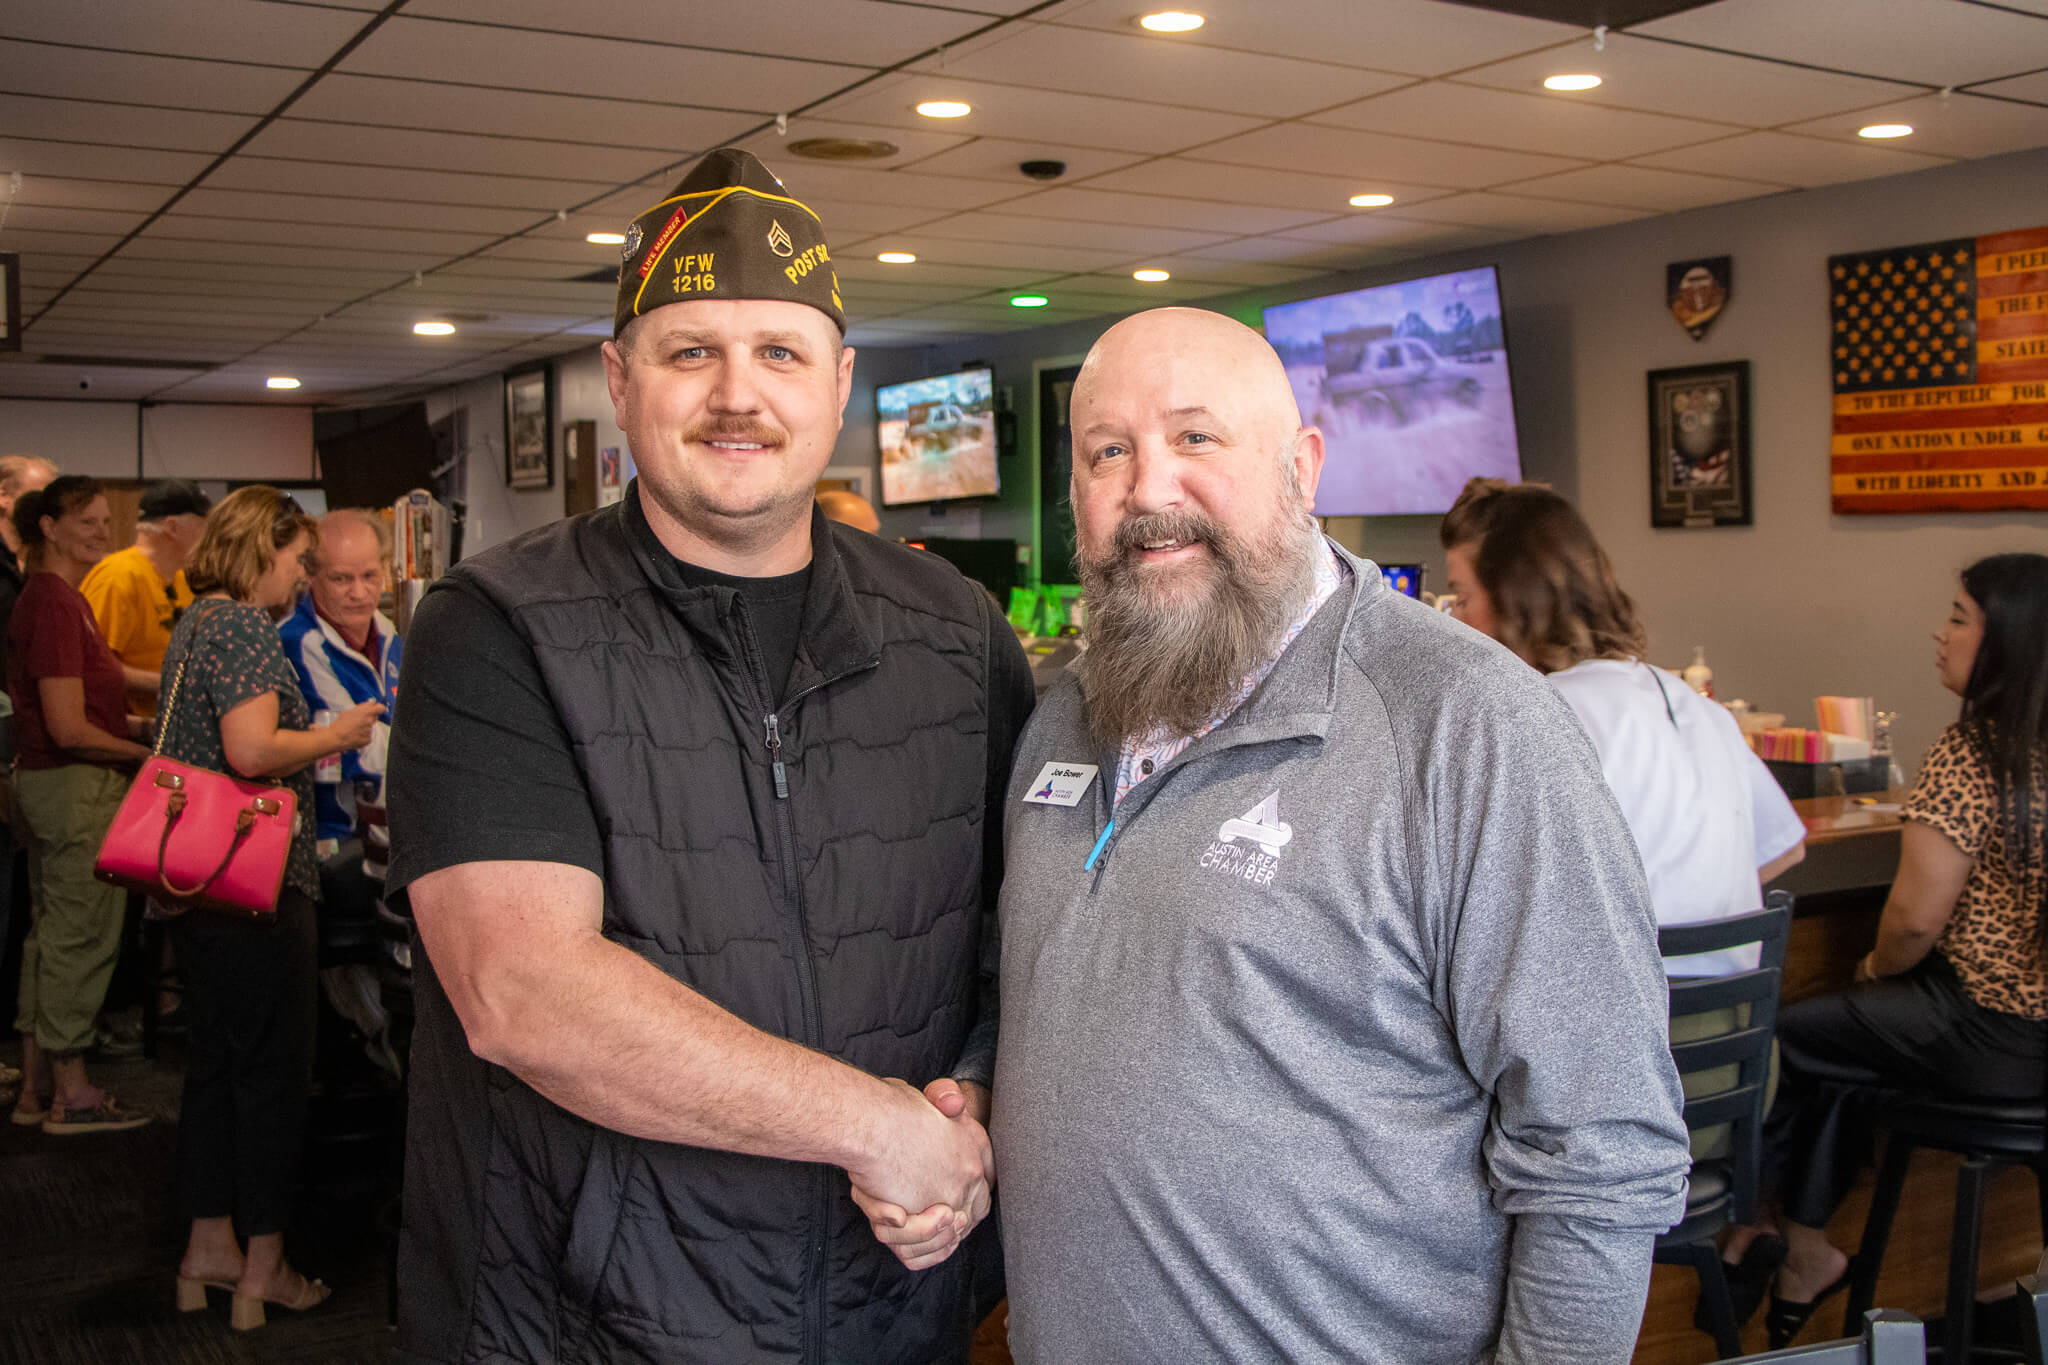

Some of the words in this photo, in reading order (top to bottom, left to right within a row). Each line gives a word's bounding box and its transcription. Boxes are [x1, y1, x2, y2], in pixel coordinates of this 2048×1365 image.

[642, 251, 657, 272] LIFE
[655, 216, 681, 252] MEMBER
[674, 252, 715, 274] VFW
[784, 248, 818, 285] POST
[672, 273, 716, 293] 1216
[1996, 296, 2030, 314] THE
[1853, 395, 1873, 410] TO
[1878, 393, 1906, 409] THE
[1914, 387, 1992, 406] REPUBLIC
[2011, 384, 2046, 401] FOR
[1852, 436, 1883, 451] ONE
[1890, 432, 1954, 449] NATION
[1960, 429, 2022, 446] UNDER
[1855, 476, 1901, 491] WITH
[1907, 473, 1984, 490] LIBERTY
[2000, 470, 2036, 487] AND
[1051, 768, 1064, 777] Joe
[1205, 841, 1246, 859] AUSTIN
[1246, 850, 1278, 872] AREA
[1200, 852, 1275, 887] CHAMBER
